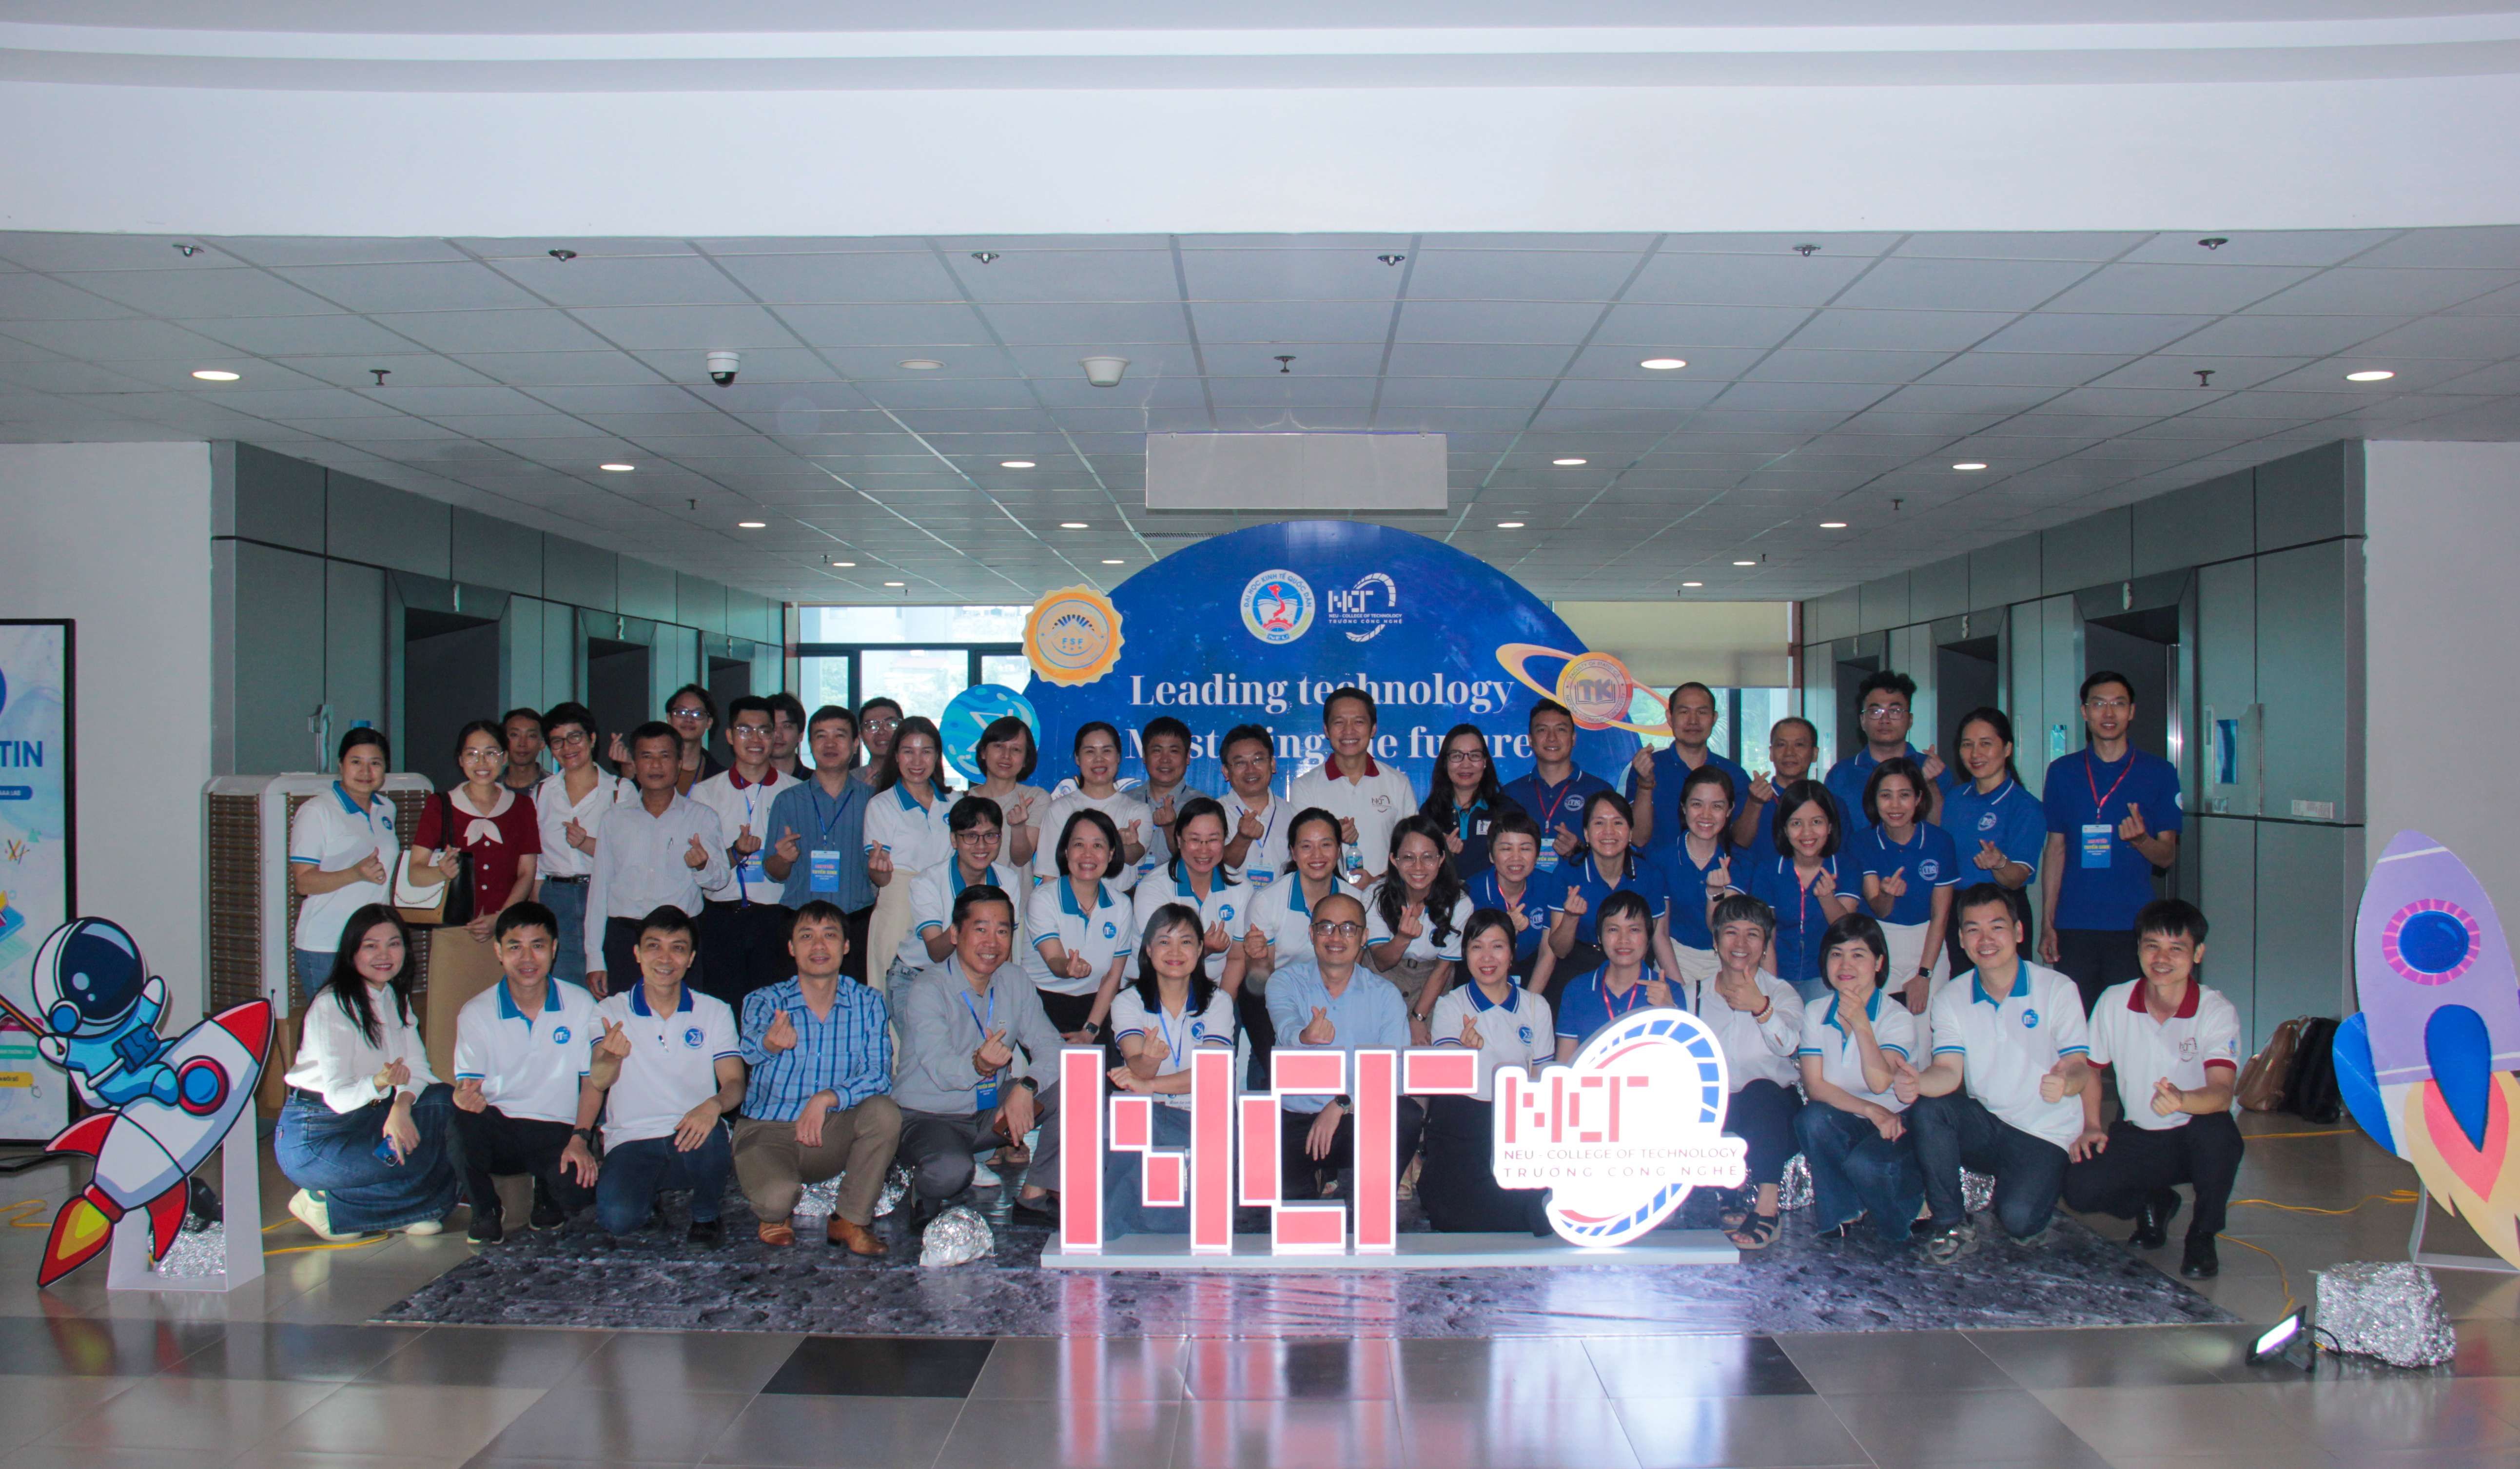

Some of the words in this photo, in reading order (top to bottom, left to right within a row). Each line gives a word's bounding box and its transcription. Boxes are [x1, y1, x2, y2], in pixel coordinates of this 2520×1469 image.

[1261, 573, 1277, 582] KINH
[1130, 673, 1289, 714] Leading
[1297, 672, 1514, 714] tehnology
[1578, 678, 1612, 702] TK
[1504, 1150, 1534, 1160] NEU
[1546, 1149, 1612, 1160] COLLEGE
[1616, 1149, 1636, 1159] OF
[1641, 1148, 1738, 1159] TECHNOLOGY
